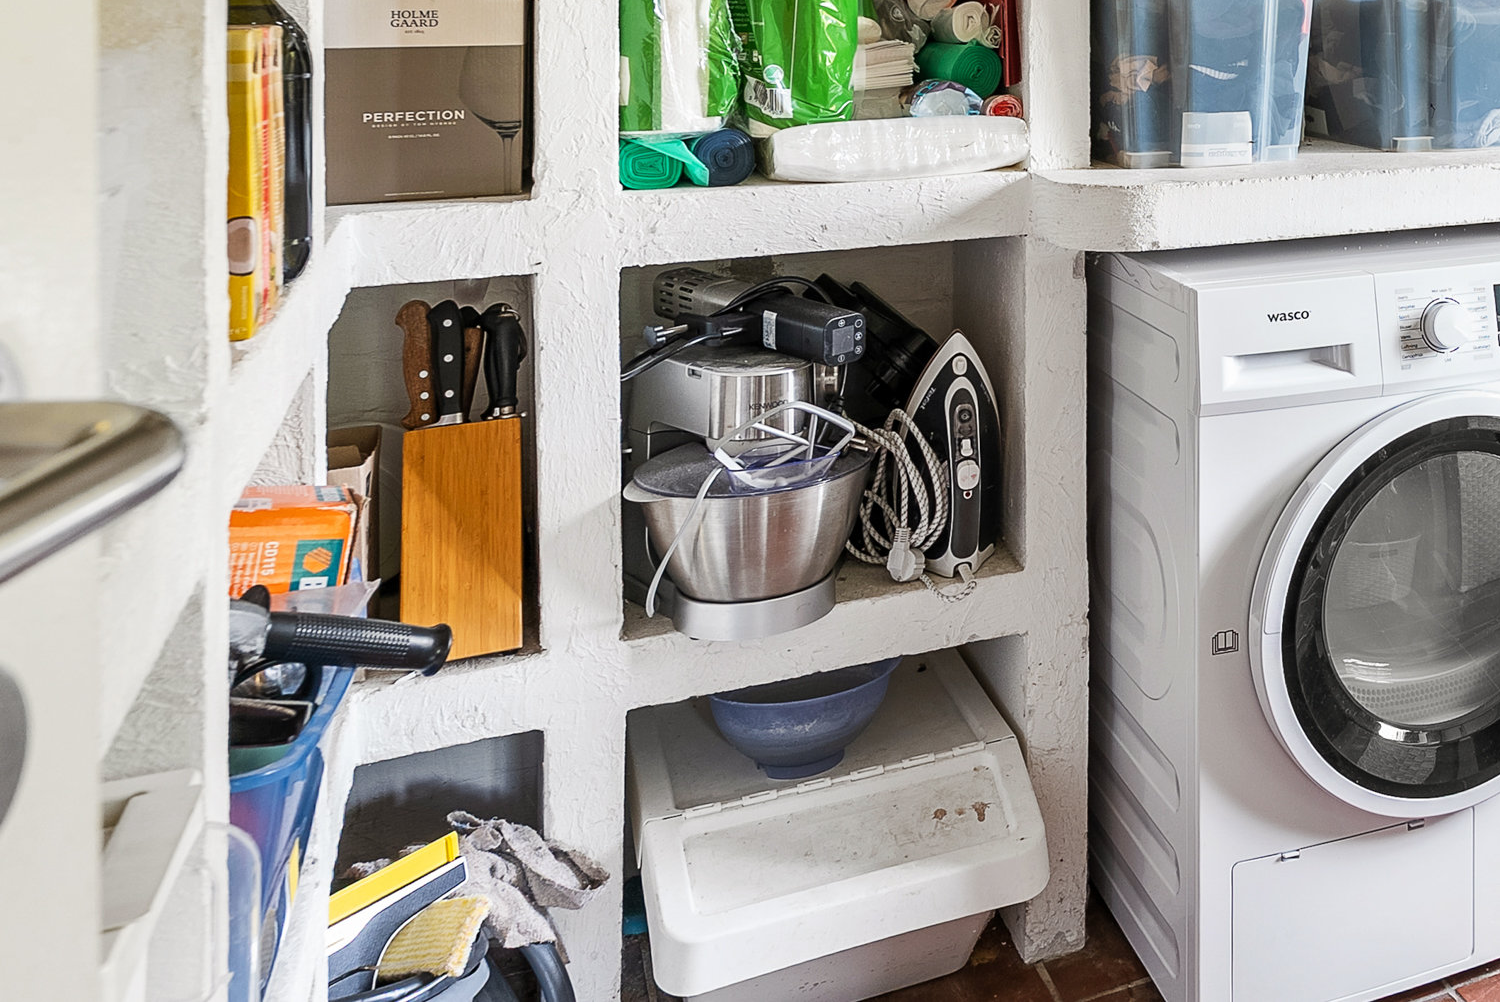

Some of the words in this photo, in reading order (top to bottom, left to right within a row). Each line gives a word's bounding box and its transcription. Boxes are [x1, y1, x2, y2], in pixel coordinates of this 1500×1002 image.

[391, 10, 439, 19] HOLME
[390, 19, 439, 28] GAARD
[362, 109, 466, 123] PERFECTION
[1267, 310, 1310, 323] wasco
[260, 541, 279, 576] CD115
